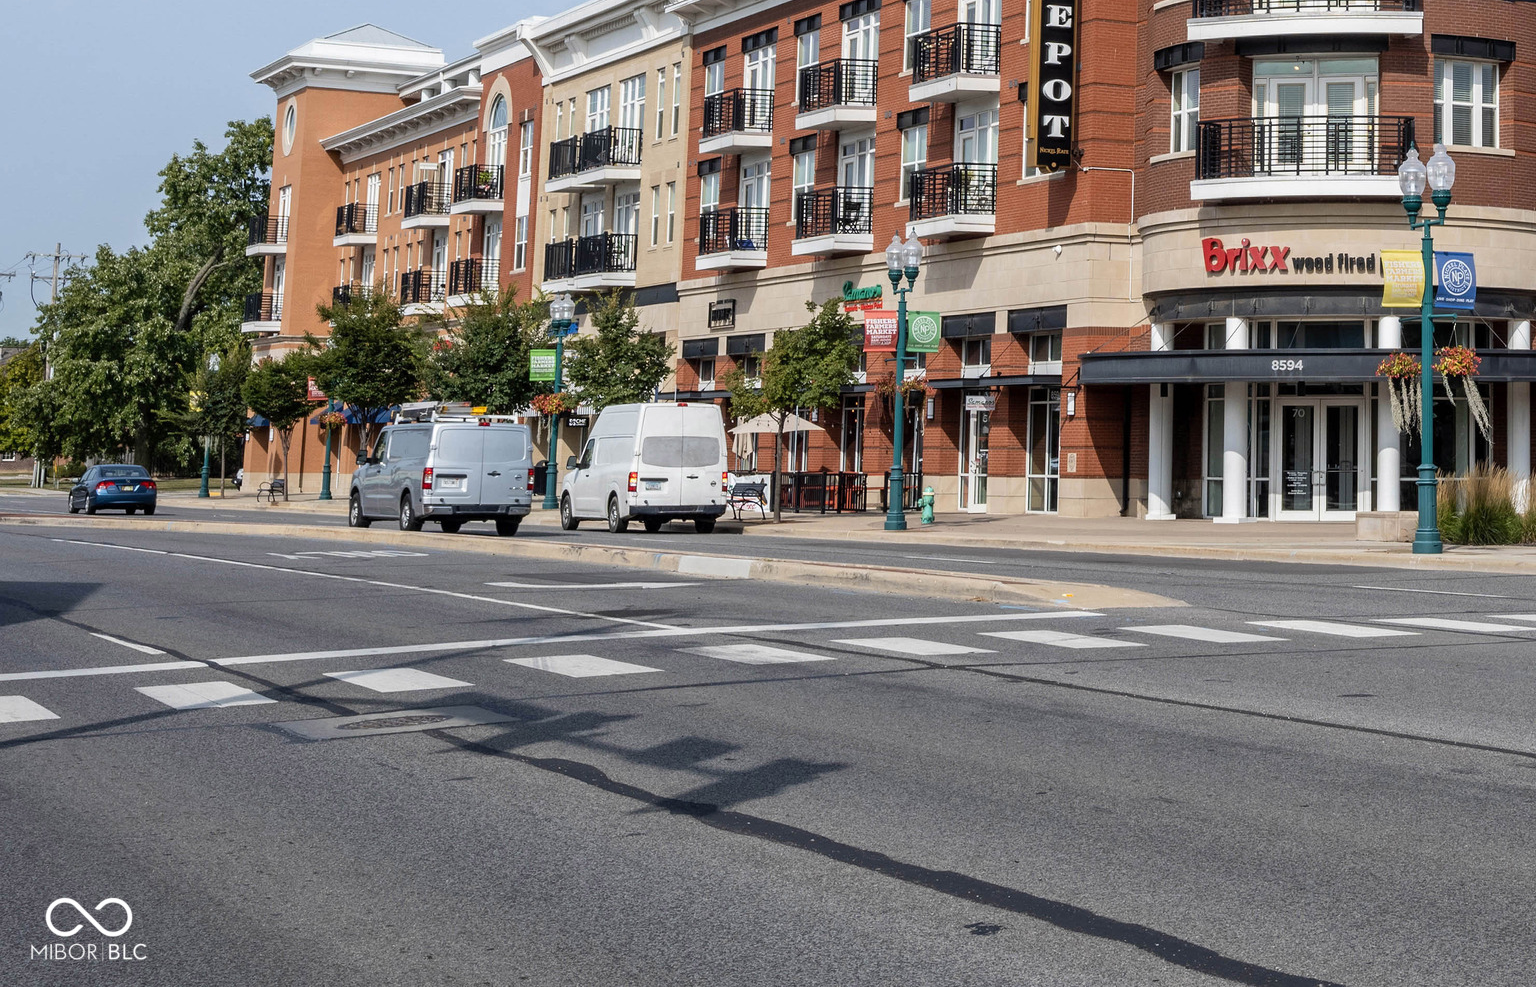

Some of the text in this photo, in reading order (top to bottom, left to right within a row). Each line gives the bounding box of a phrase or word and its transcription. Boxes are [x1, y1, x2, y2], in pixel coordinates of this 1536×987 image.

[1202, 237, 1290, 273] Brixx
[1292, 253, 1334, 273] wood
[1337, 253, 1376, 273] fired
[1271, 359, 1304, 371] 8594
[1292, 408, 1305, 418] 70
